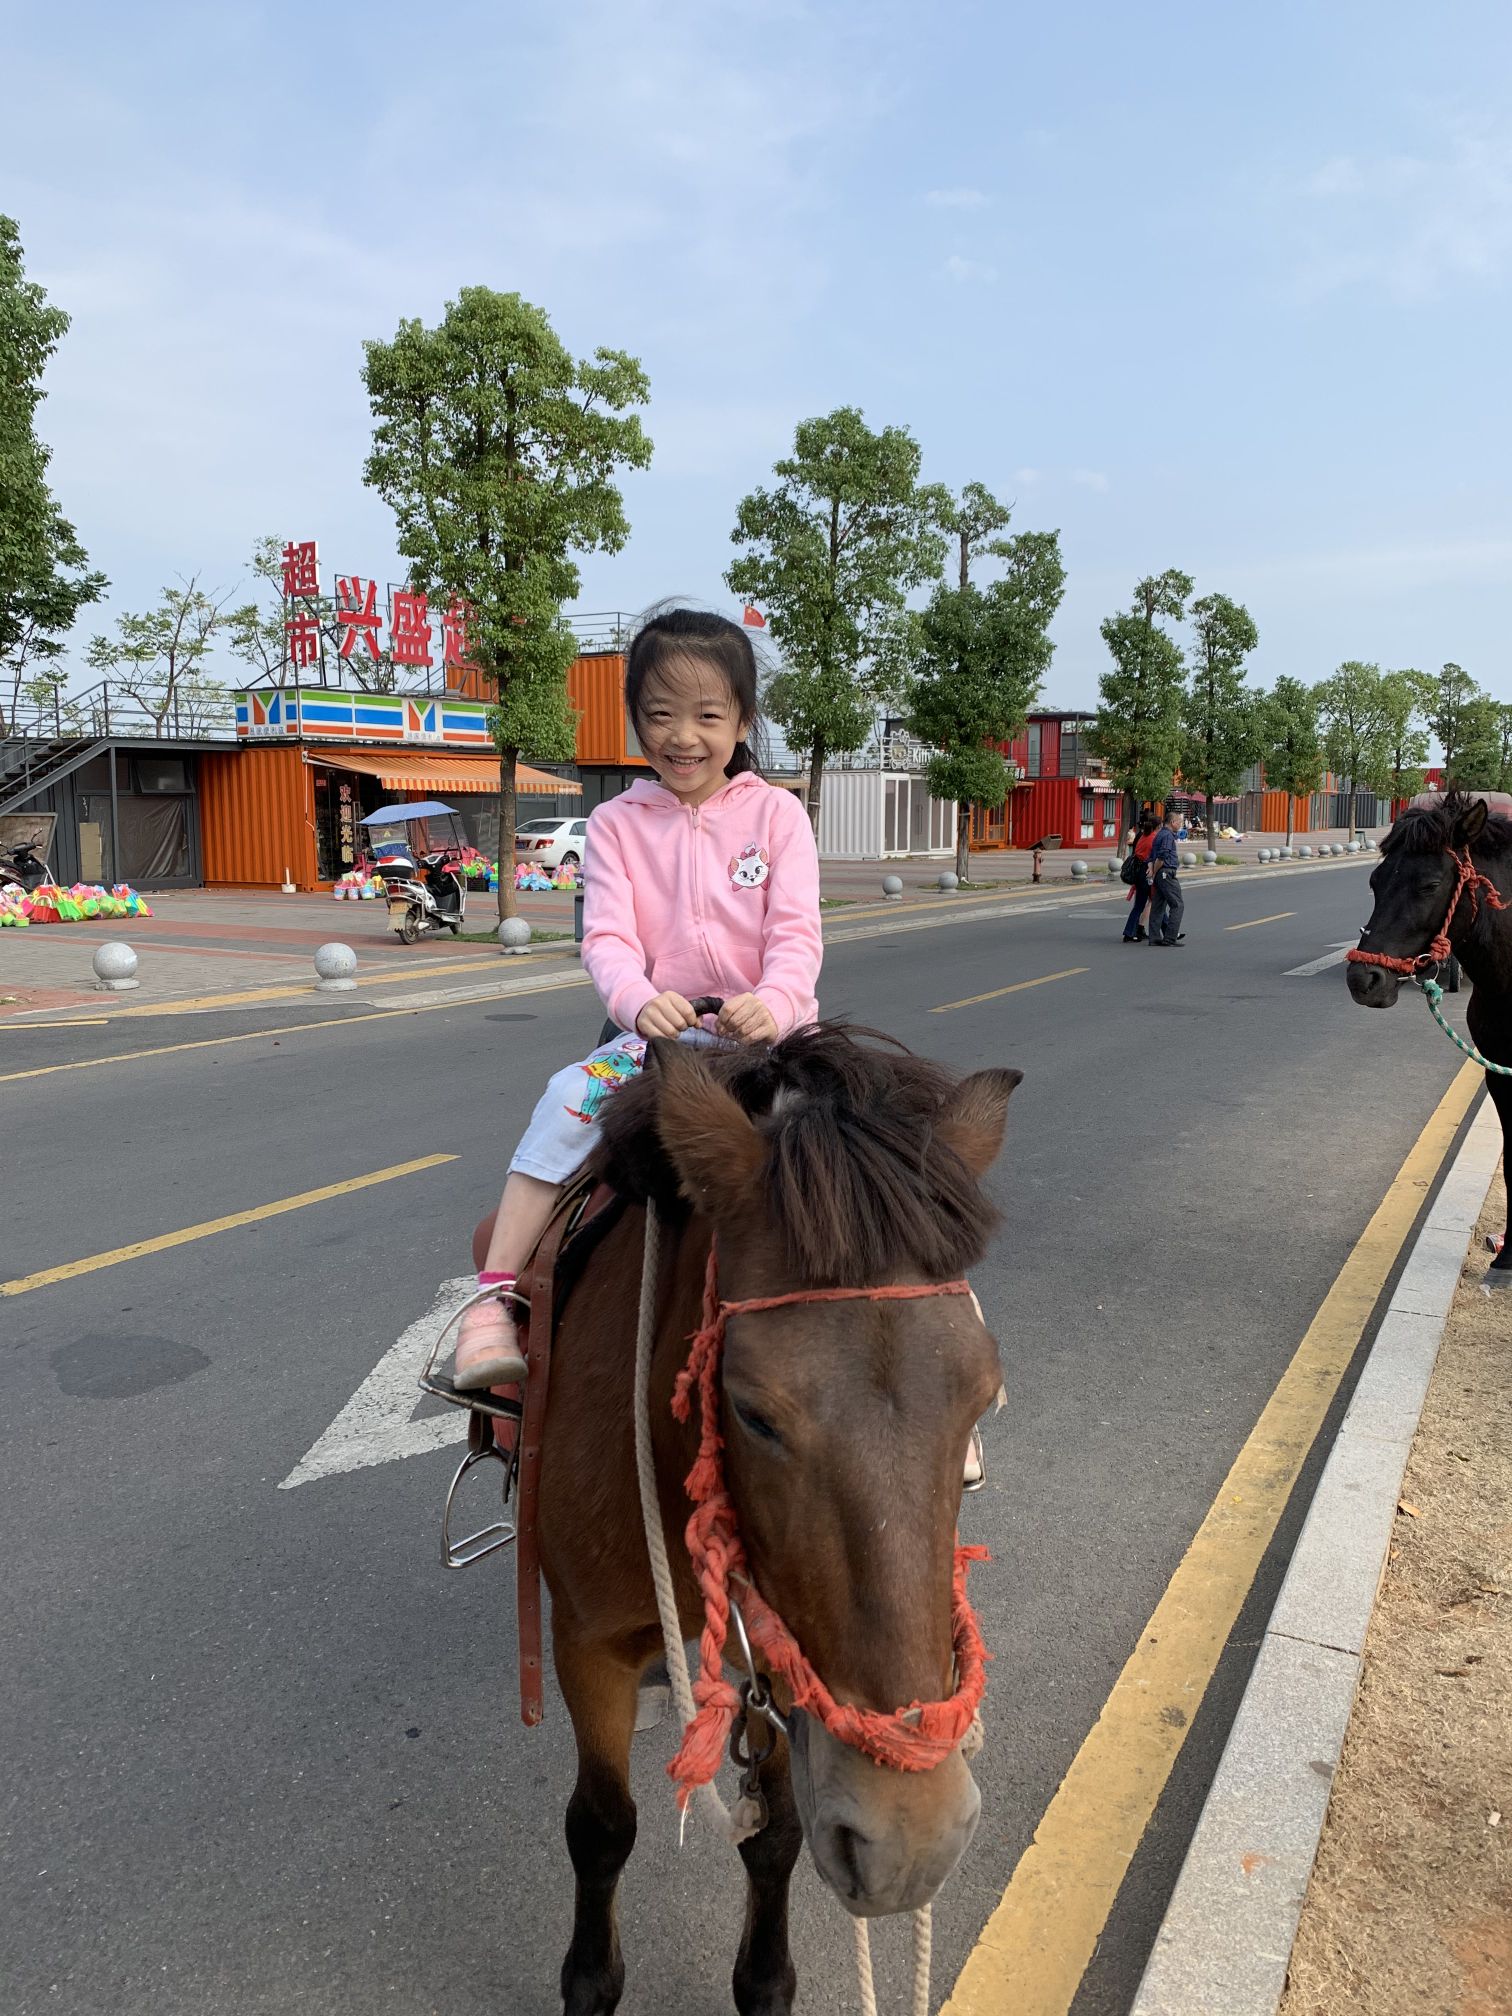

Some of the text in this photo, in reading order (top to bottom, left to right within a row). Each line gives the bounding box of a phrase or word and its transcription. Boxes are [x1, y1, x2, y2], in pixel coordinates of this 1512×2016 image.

[281, 541, 322, 667] 超市
[337, 576, 527, 673] 兴盛超
[340, 784, 354, 863] 欢迎光临
